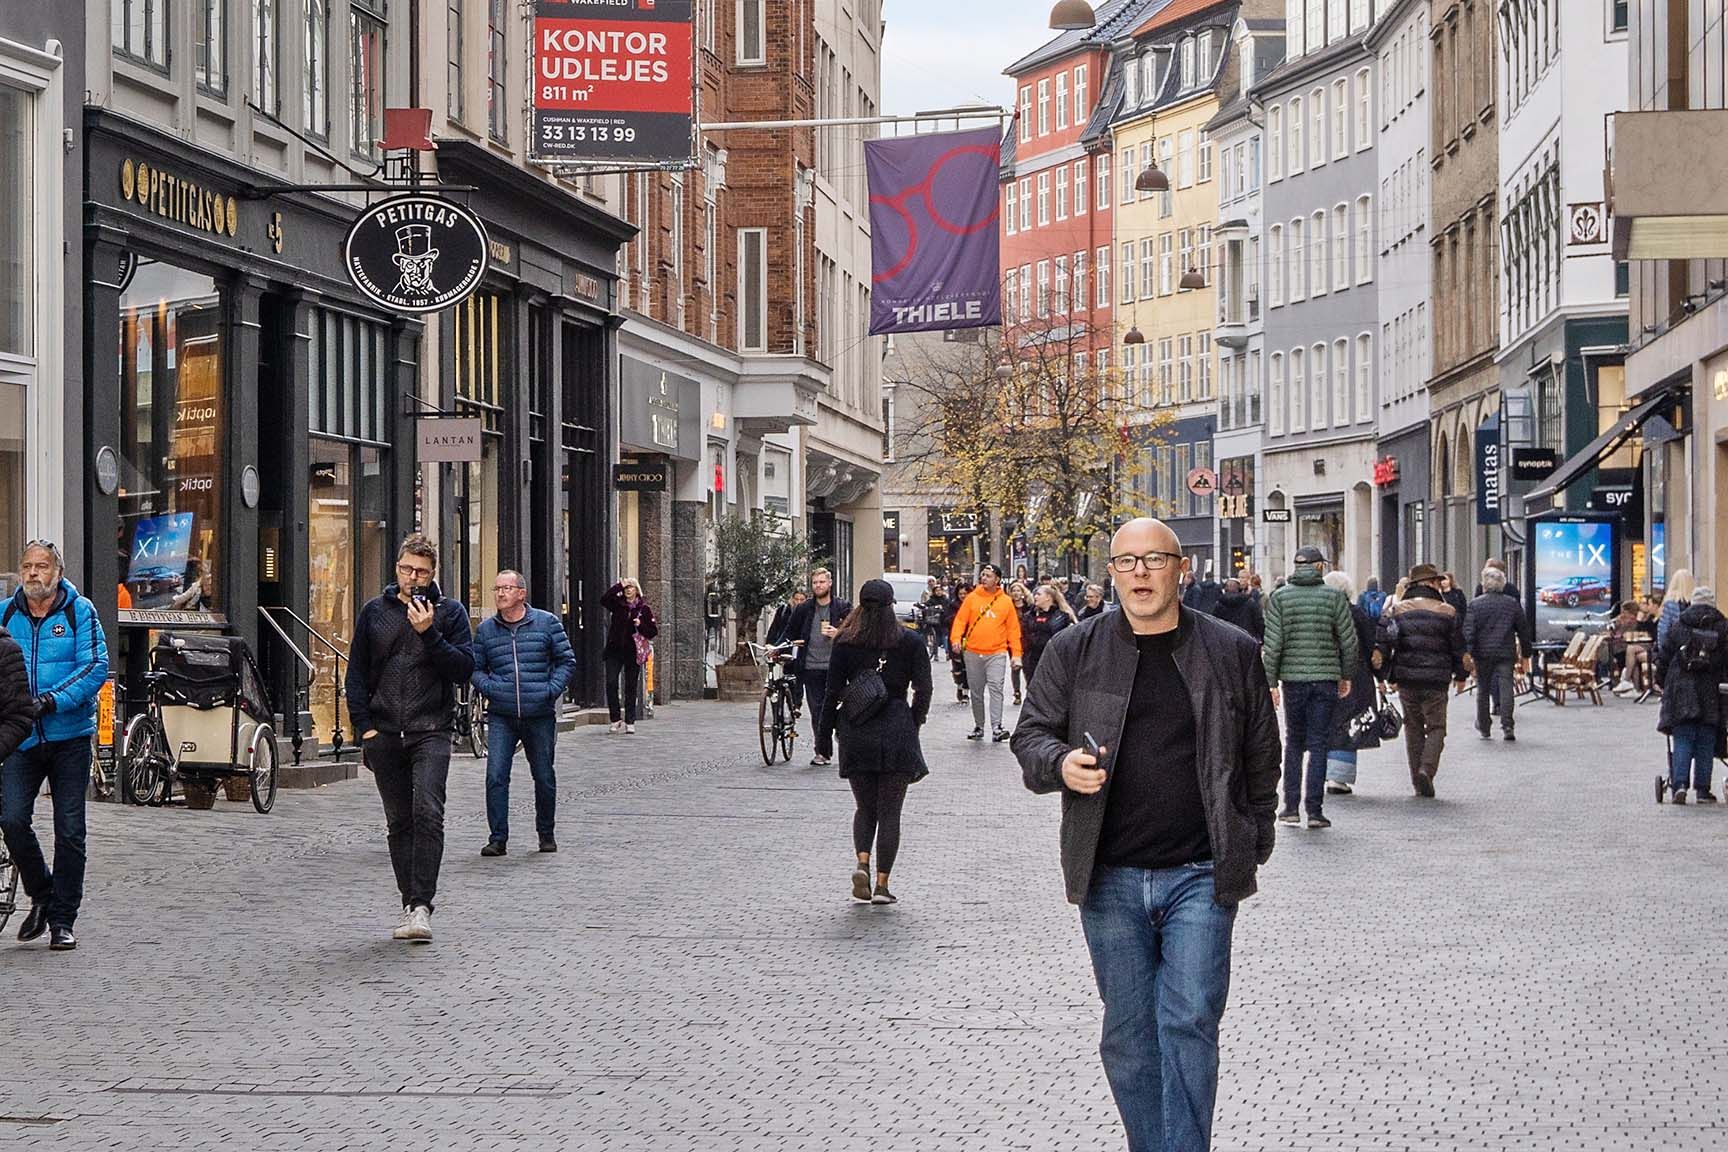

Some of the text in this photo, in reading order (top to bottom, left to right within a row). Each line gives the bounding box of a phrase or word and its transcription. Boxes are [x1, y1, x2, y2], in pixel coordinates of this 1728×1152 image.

[543, 29, 667, 55] KONTOR
[542, 57, 668, 82] UDLEJES
[542, 86, 566, 100] 811
[543, 126, 635, 142] 33 13 13 99
[150, 168, 212, 232] PETITGAS
[375, 204, 458, 228] PETITGAS
[892, 301, 981, 325] THIELE
[425, 436, 473, 444] LANTAN
[1518, 460, 1552, 468] synoptik
[1483, 444, 1498, 509] matas
[1266, 511, 1288, 520] VANS
[1551, 544, 1605, 566] THE iX
